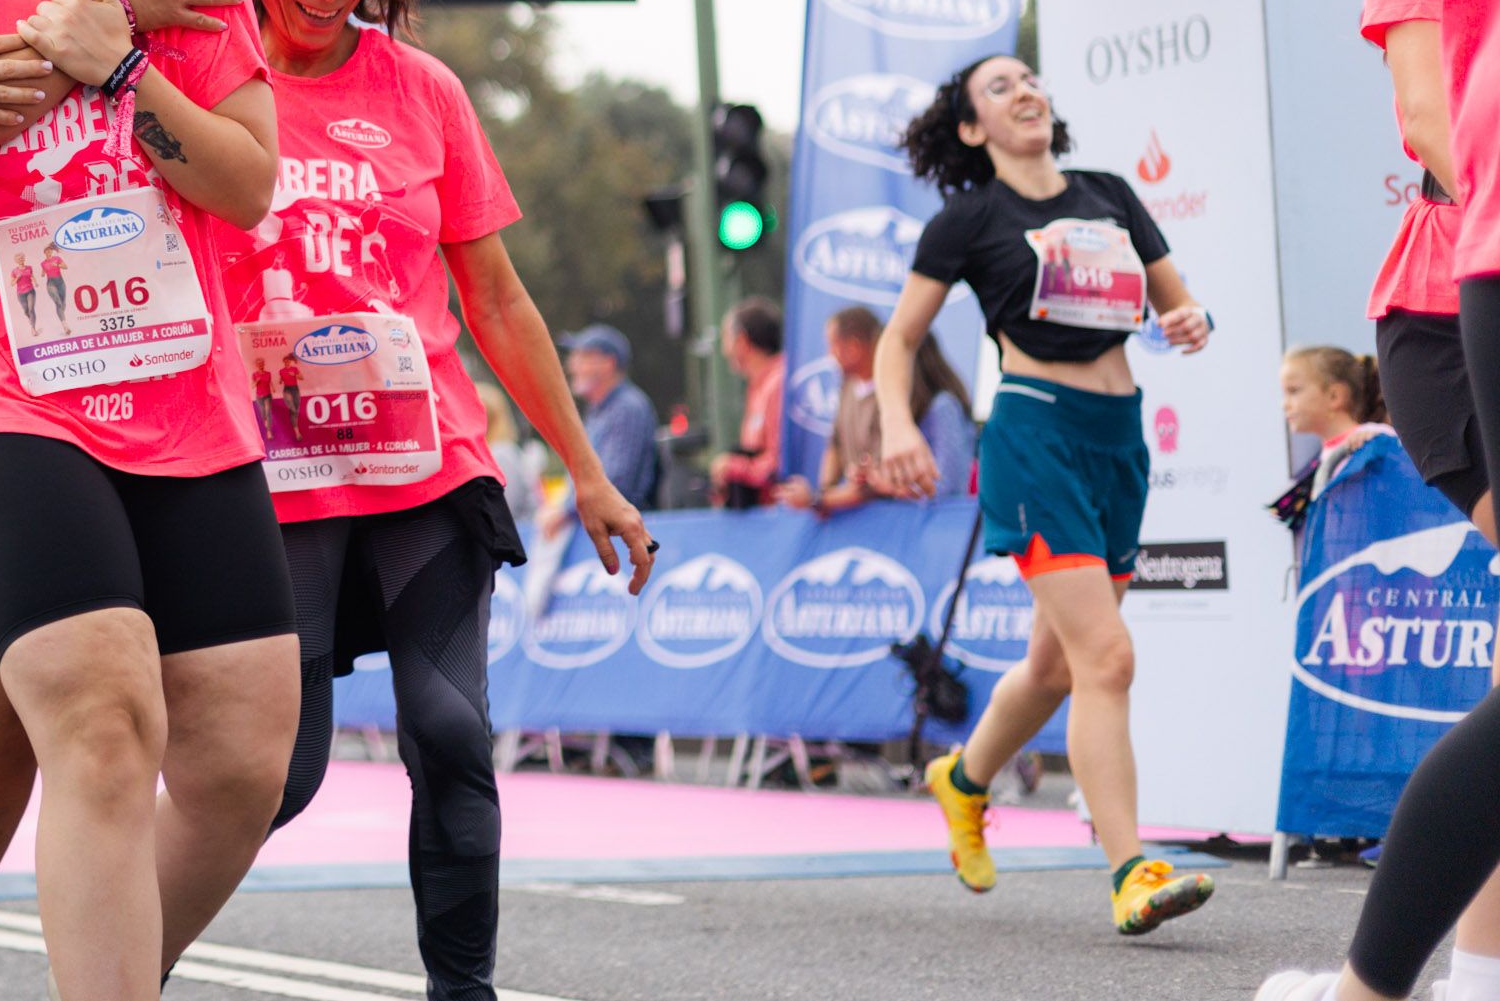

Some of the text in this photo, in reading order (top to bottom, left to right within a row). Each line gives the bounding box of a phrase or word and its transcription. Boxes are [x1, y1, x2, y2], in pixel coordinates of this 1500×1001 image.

[1085, 12, 1211, 87] OYSHO
[11, 228, 50, 244] SUMA
[19, 220, 48, 233] DORSAL
[63, 222, 139, 246] ASTURIANA
[74, 276, 150, 315] 016
[99, 315, 136, 332] 3375
[34, 323, 195, 360] CARRERA DE LA MUJER A CORUÑA
[252, 337, 288, 349] SUMA
[301, 341, 372, 358] ASTURIANA
[145, 349, 195, 366] Santander
[42, 359, 106, 382] OYSHO
[81, 391, 134, 423] 2026
[306, 391, 377, 424] 016
[336, 428, 354, 440] 88
[269, 446, 309, 459] CARRERA
[311, 445, 323, 454] DE
[325, 443, 338, 453] LA
[339, 440, 371, 453] MUJER
[384, 438, 421, 451] CORUÑA
[278, 463, 333, 481] OYSHO
[369, 463, 420, 475] Santander
[1366, 586, 1487, 609] CENTRAL
